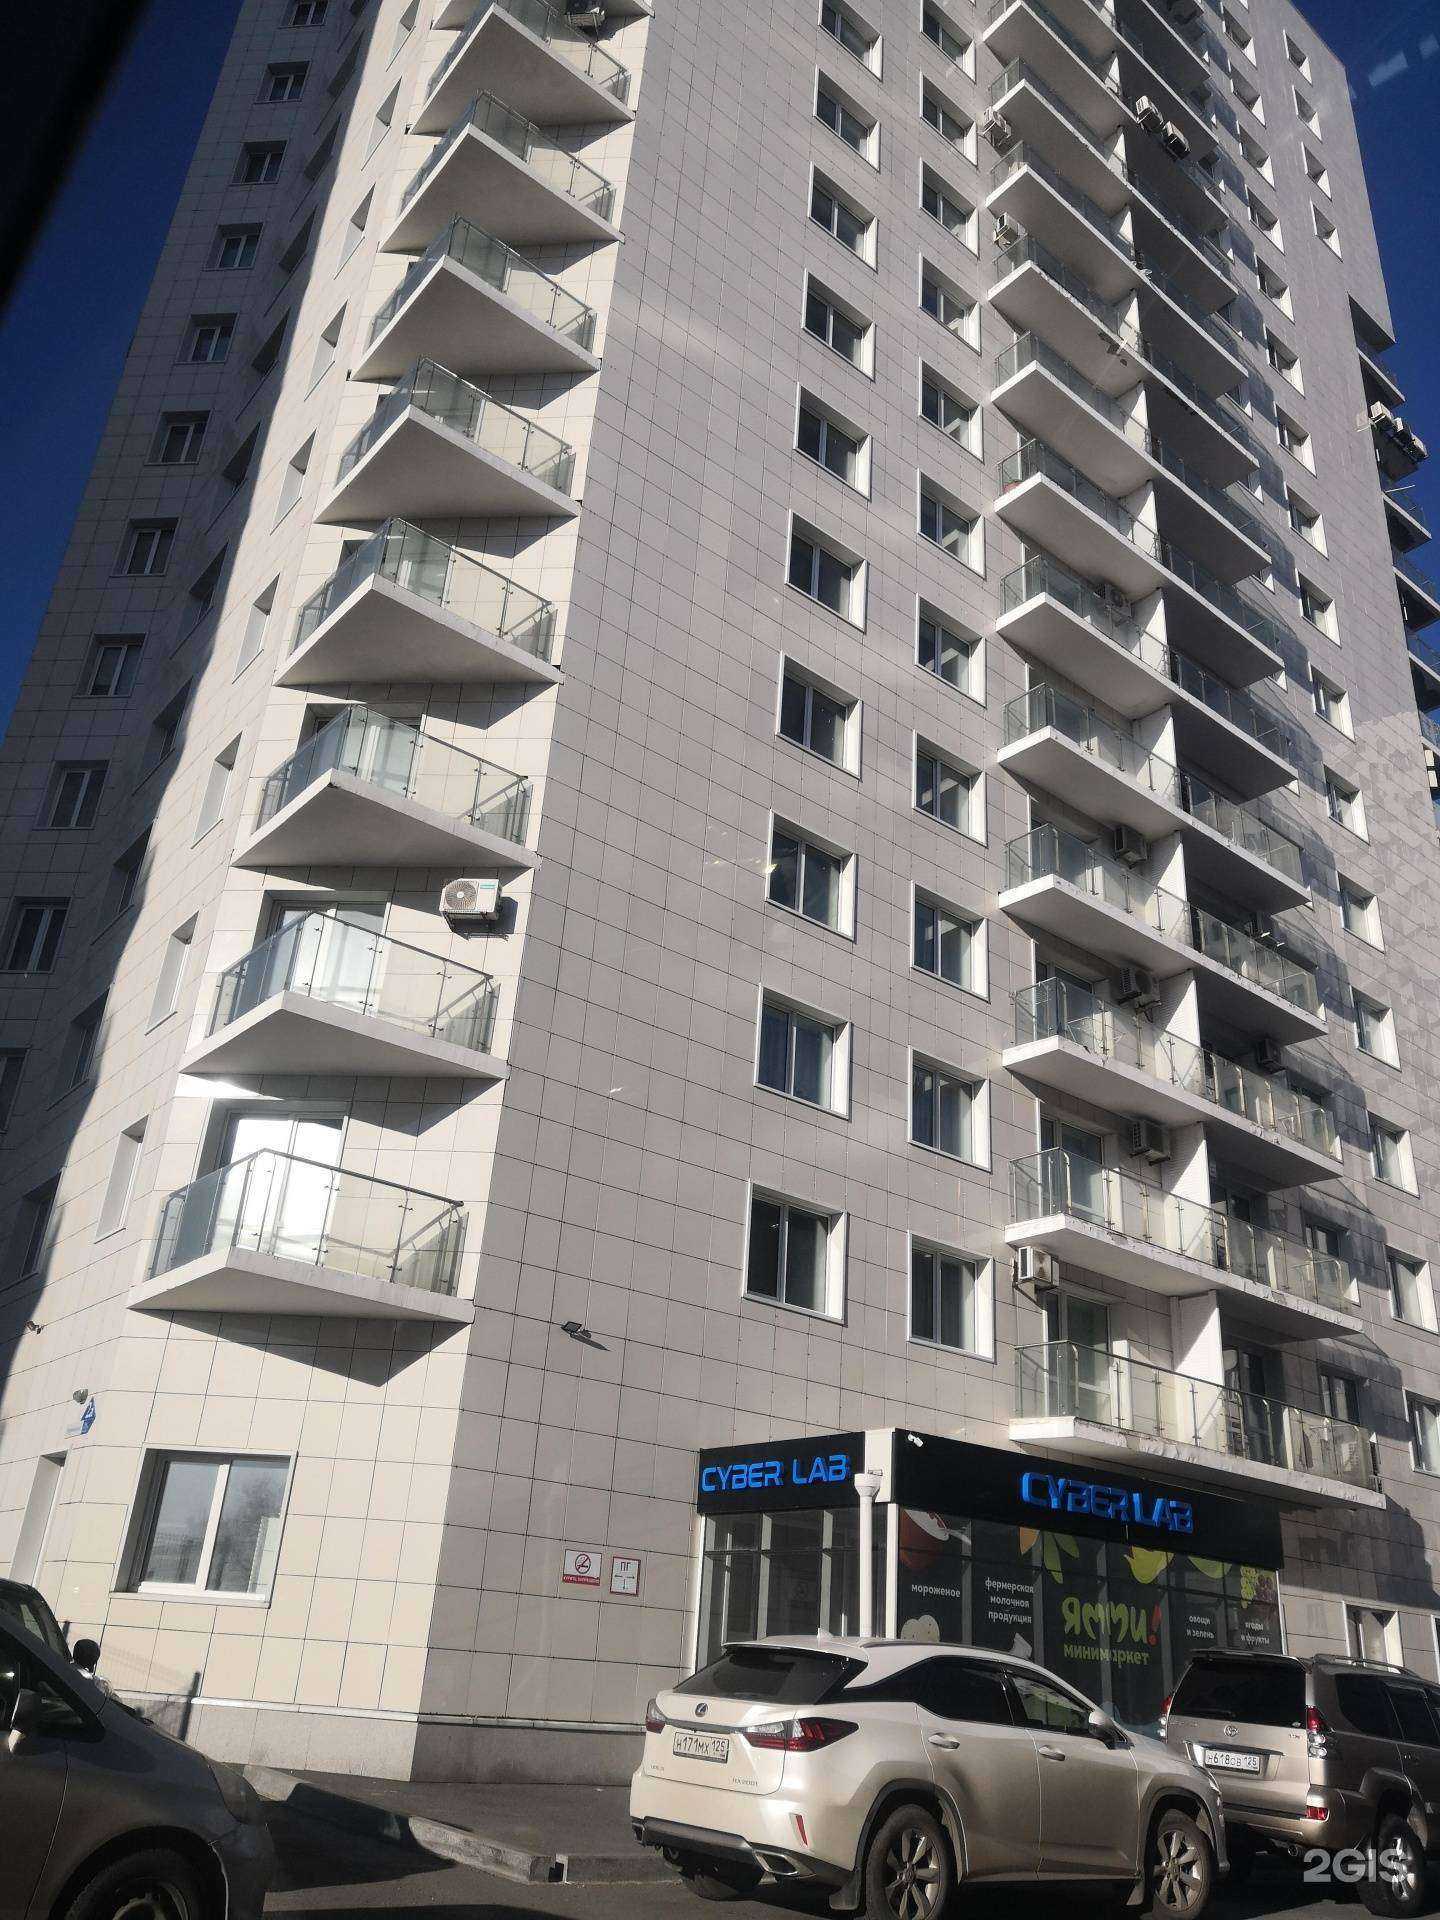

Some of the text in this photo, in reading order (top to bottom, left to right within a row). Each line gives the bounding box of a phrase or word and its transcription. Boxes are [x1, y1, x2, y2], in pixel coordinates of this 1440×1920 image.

[702, 1454, 848, 1493] CYBER LAB
[1022, 1472, 1194, 1534] CYBER LAB
[911, 1584, 961, 1598] мороженое
[985, 1577, 1034, 1594] фермерская
[990, 1595, 1030, 1608] молочная
[988, 1611, 1032, 1625] продукция
[1189, 1615, 1211, 1625] овощи
[1064, 1643, 1149, 1668] минимаркет
